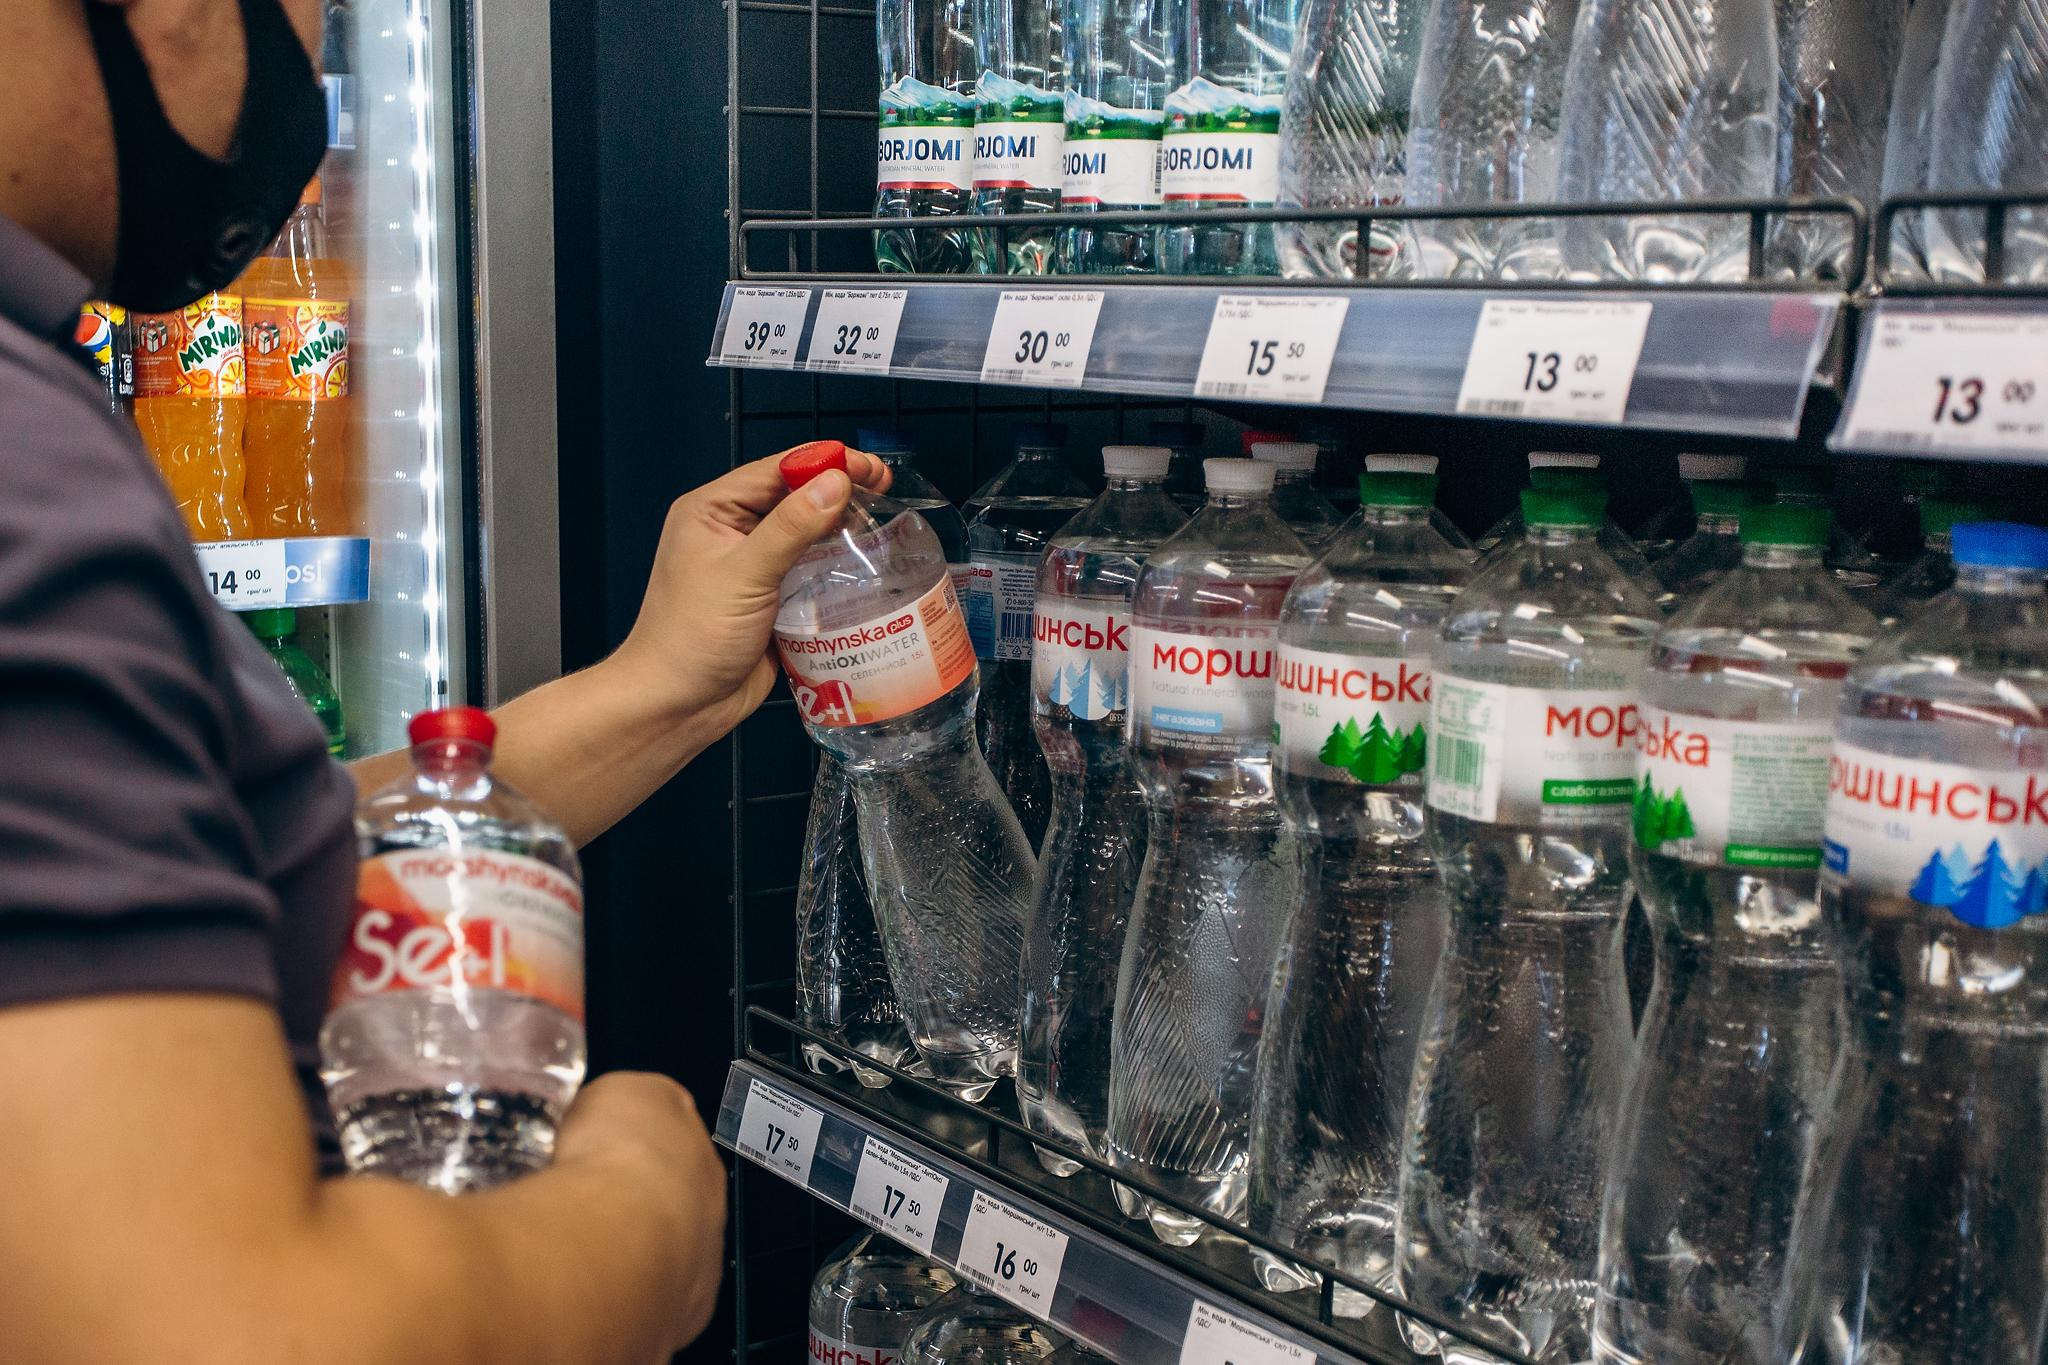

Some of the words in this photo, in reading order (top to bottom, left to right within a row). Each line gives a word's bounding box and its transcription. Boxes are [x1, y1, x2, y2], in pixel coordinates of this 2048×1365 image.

[290, 327, 347, 375] MIRIND
[744, 321, 771, 351] 39
[774, 324, 786, 338] 00
[834, 324, 862, 355] 32
[866, 327, 879, 340] 00
[1015, 330, 1049, 363] 30
[1055, 332, 1070, 347] 00
[1247, 339, 1279, 376] 15
[1286, 342, 1305, 358] 50
[1524, 352, 1560, 392] 13
[1575, 354, 1598, 373] 00
[1934, 377, 1985, 424] 13
[208, 570, 239, 595] 14
[245, 569, 261, 581] 00
[779, 626, 887, 656] morshynska
[890, 614, 912, 634] plus
[1153, 642, 1273, 685] морш
[765, 1123, 785, 1155] 17
[787, 1136, 799, 1151] 50
[877, 1145, 889, 1154] вода
[883, 1184, 906, 1220] 17
[908, 1200, 921, 1217] 50
[987, 1200, 1000, 1210] вода
[1046, 1228, 1056, 1238] 1,5л
[916, 1230, 923, 1239] шт
[993, 1242, 1017, 1280] 16
[1023, 1258, 1038, 1276] 00
[1031, 1291, 1041, 1300] шт
[1211, 1313, 1227, 1324] вода
